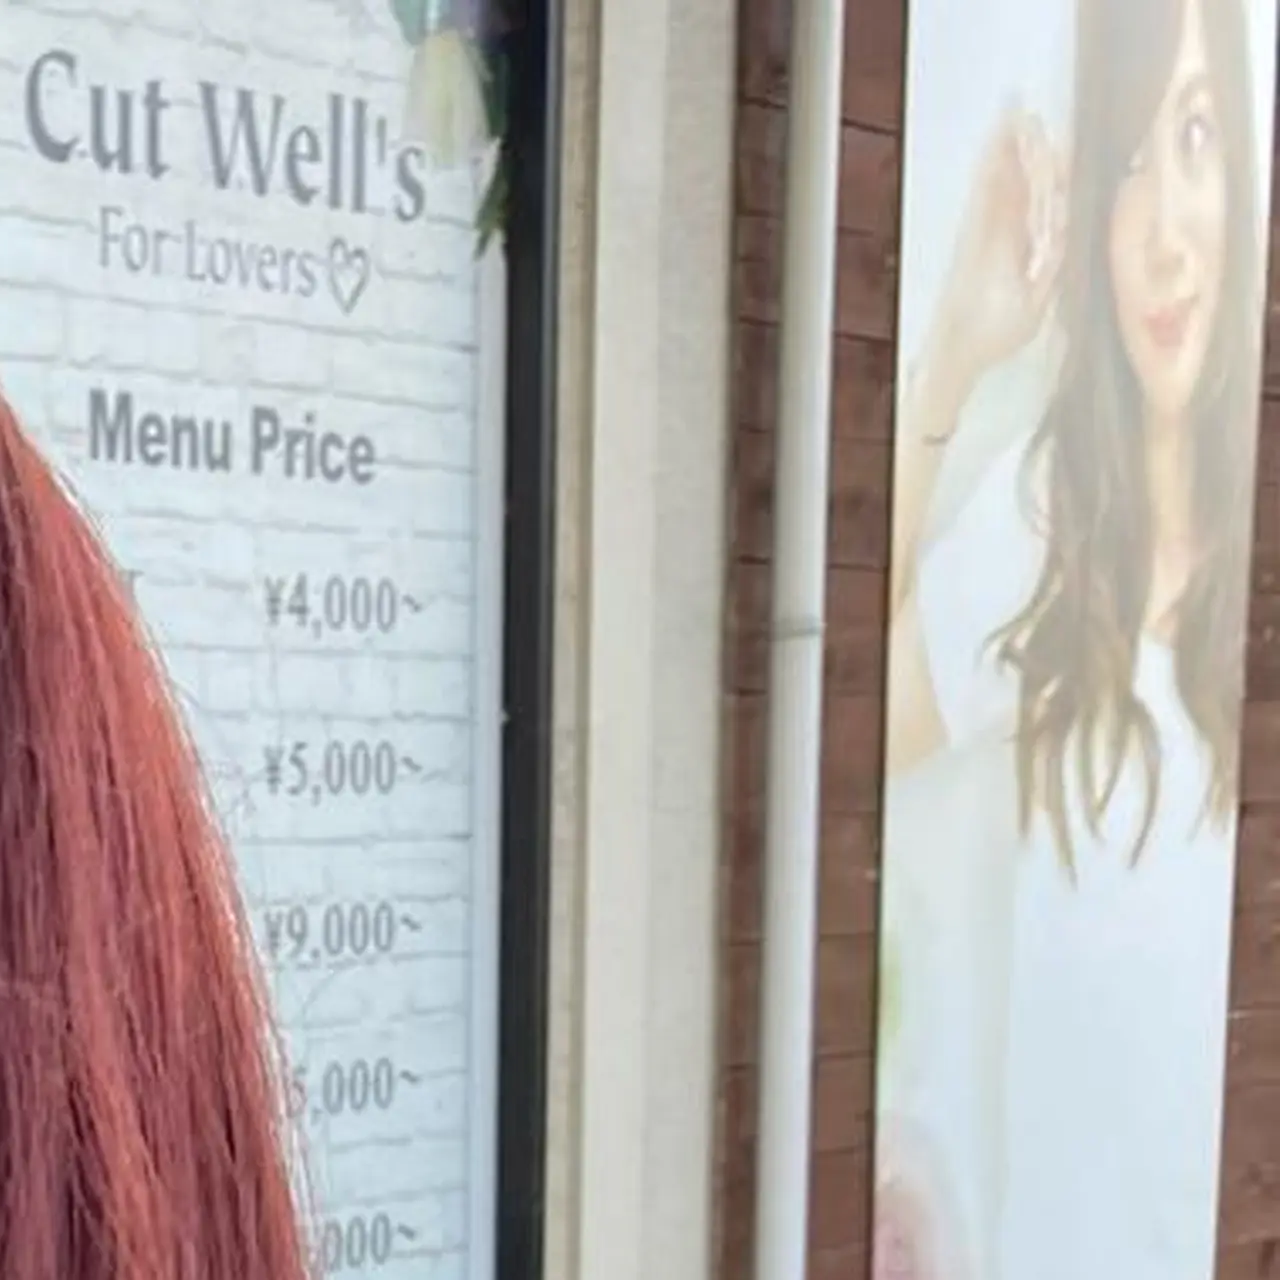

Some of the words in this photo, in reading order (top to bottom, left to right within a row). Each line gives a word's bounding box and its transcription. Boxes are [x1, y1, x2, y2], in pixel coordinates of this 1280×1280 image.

[25, 50, 170, 180] Cut
[198, 81, 427, 223] Well's
[99, 205, 183, 275] For
[185, 219, 318, 298] Lovers
[88, 388, 233, 472] Menu
[251, 406, 376, 485] Price
